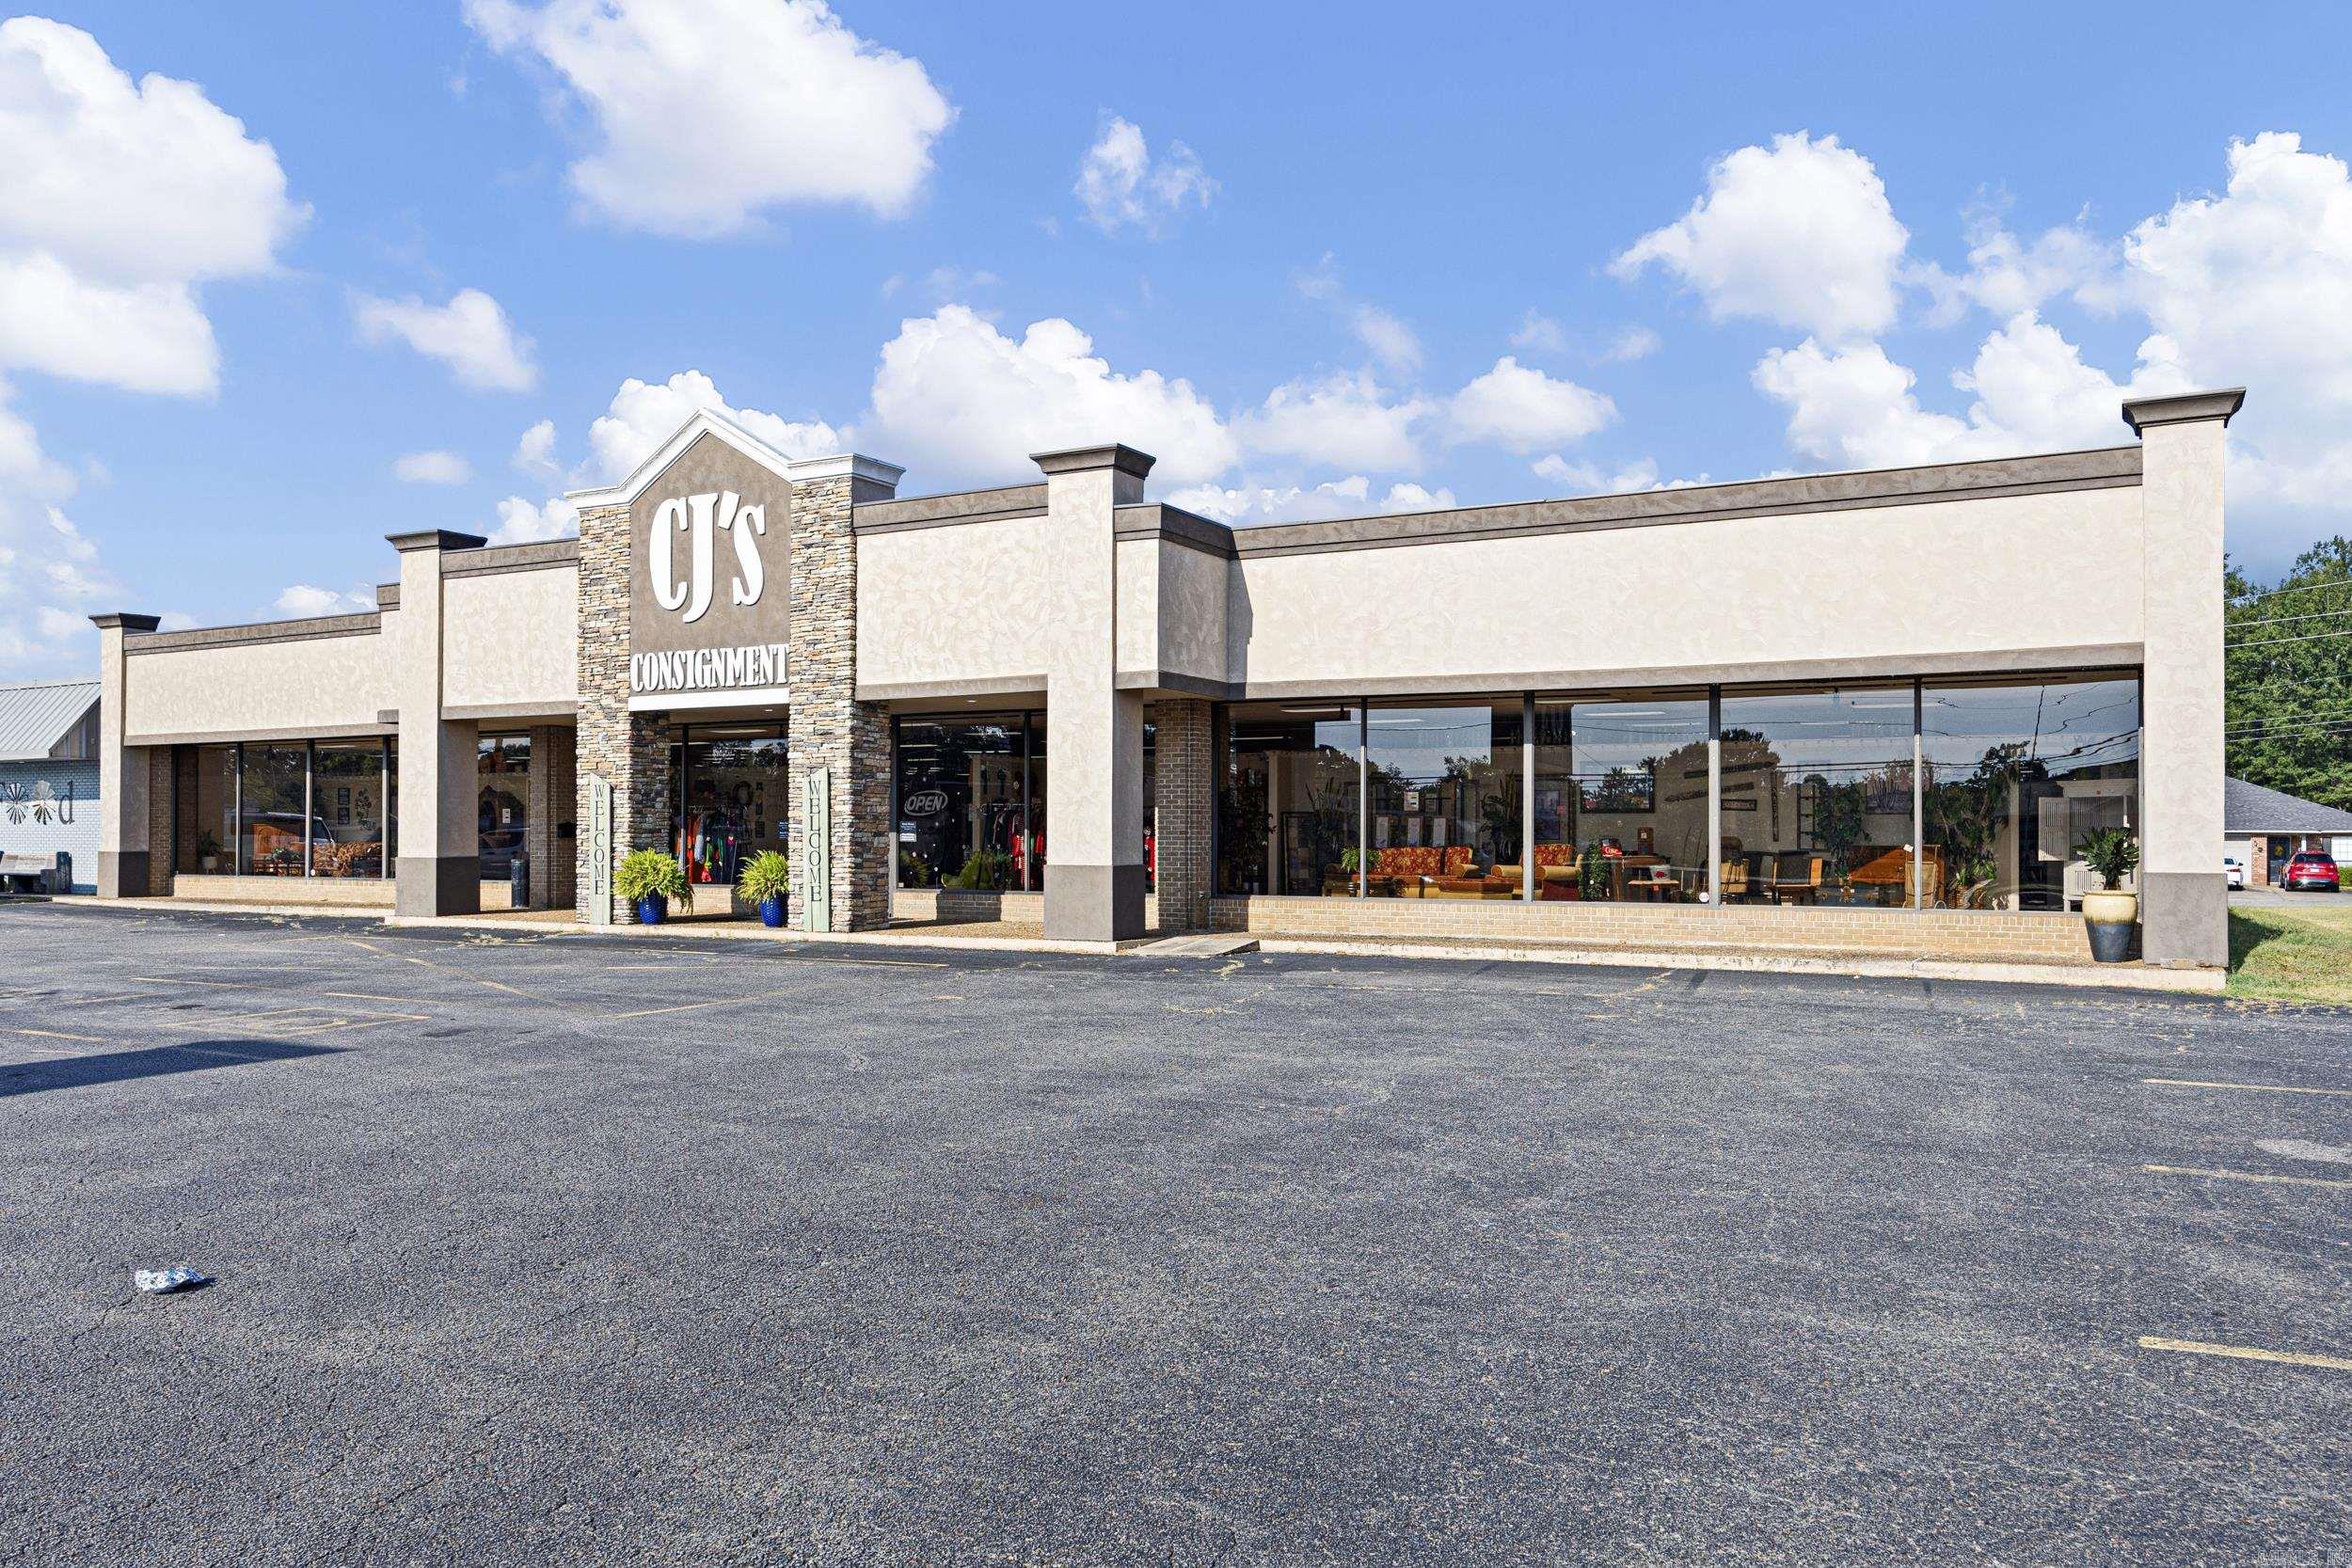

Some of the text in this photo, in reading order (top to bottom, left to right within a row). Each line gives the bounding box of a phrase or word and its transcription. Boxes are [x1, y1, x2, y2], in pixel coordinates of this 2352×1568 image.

[629, 643, 788, 692] CONSIGNMENT
[594, 784, 605, 895] WELCOME
[809, 779, 821, 902] WELCOME
[906, 796, 944, 811] OPEN
